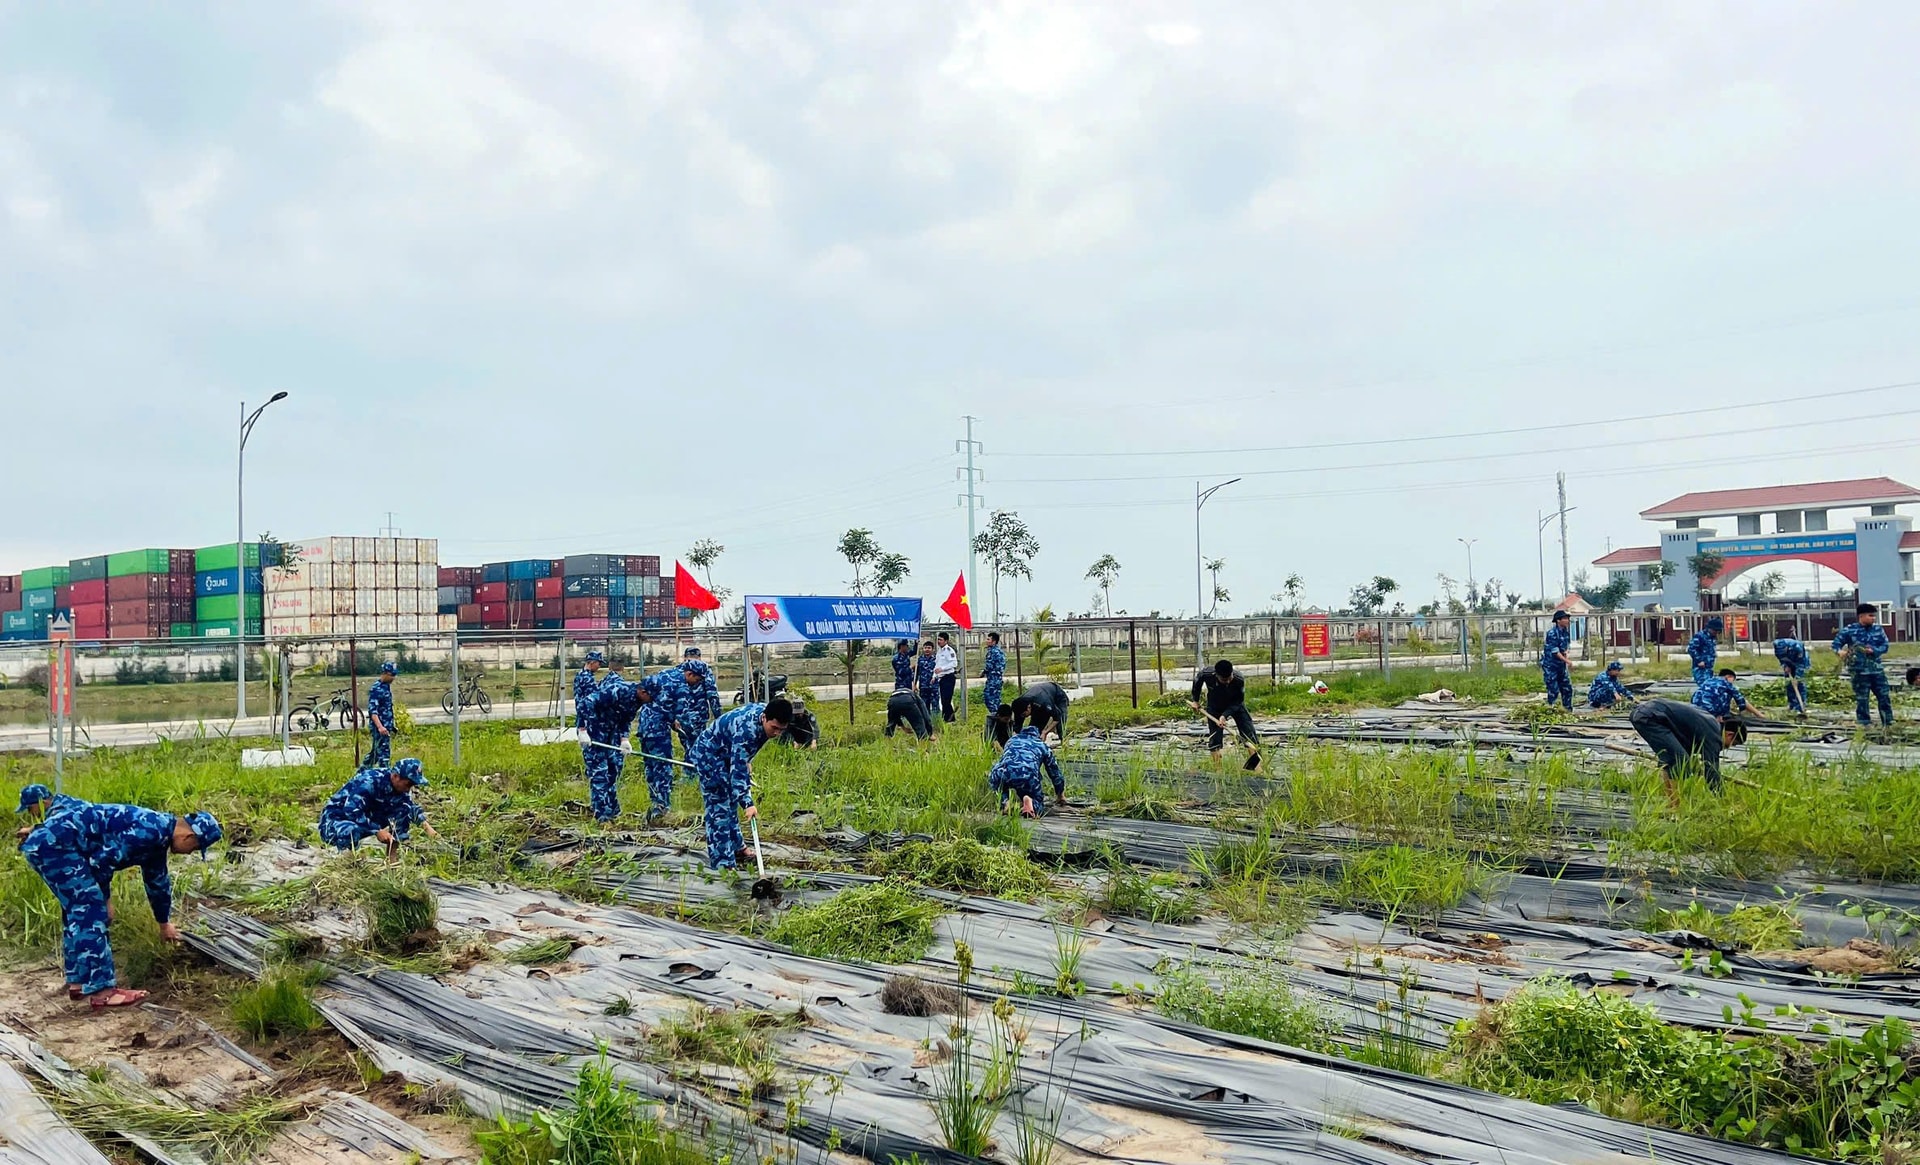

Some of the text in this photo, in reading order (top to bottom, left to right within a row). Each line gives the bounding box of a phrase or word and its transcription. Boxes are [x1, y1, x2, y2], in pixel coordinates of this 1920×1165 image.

[832, 600, 896, 616] TUỔI TRẺ HẢI ĐOÀN 11
[805, 621, 816, 635] RA
[816, 618, 835, 635] QUÂN
[834, 620, 851, 636] THỰC
[851, 618, 867, 636] HIỆN
[867, 618, 883, 633] NGÀY
[883, 617, 896, 633] CHỦ
[895, 618, 911, 635] NHẬT
